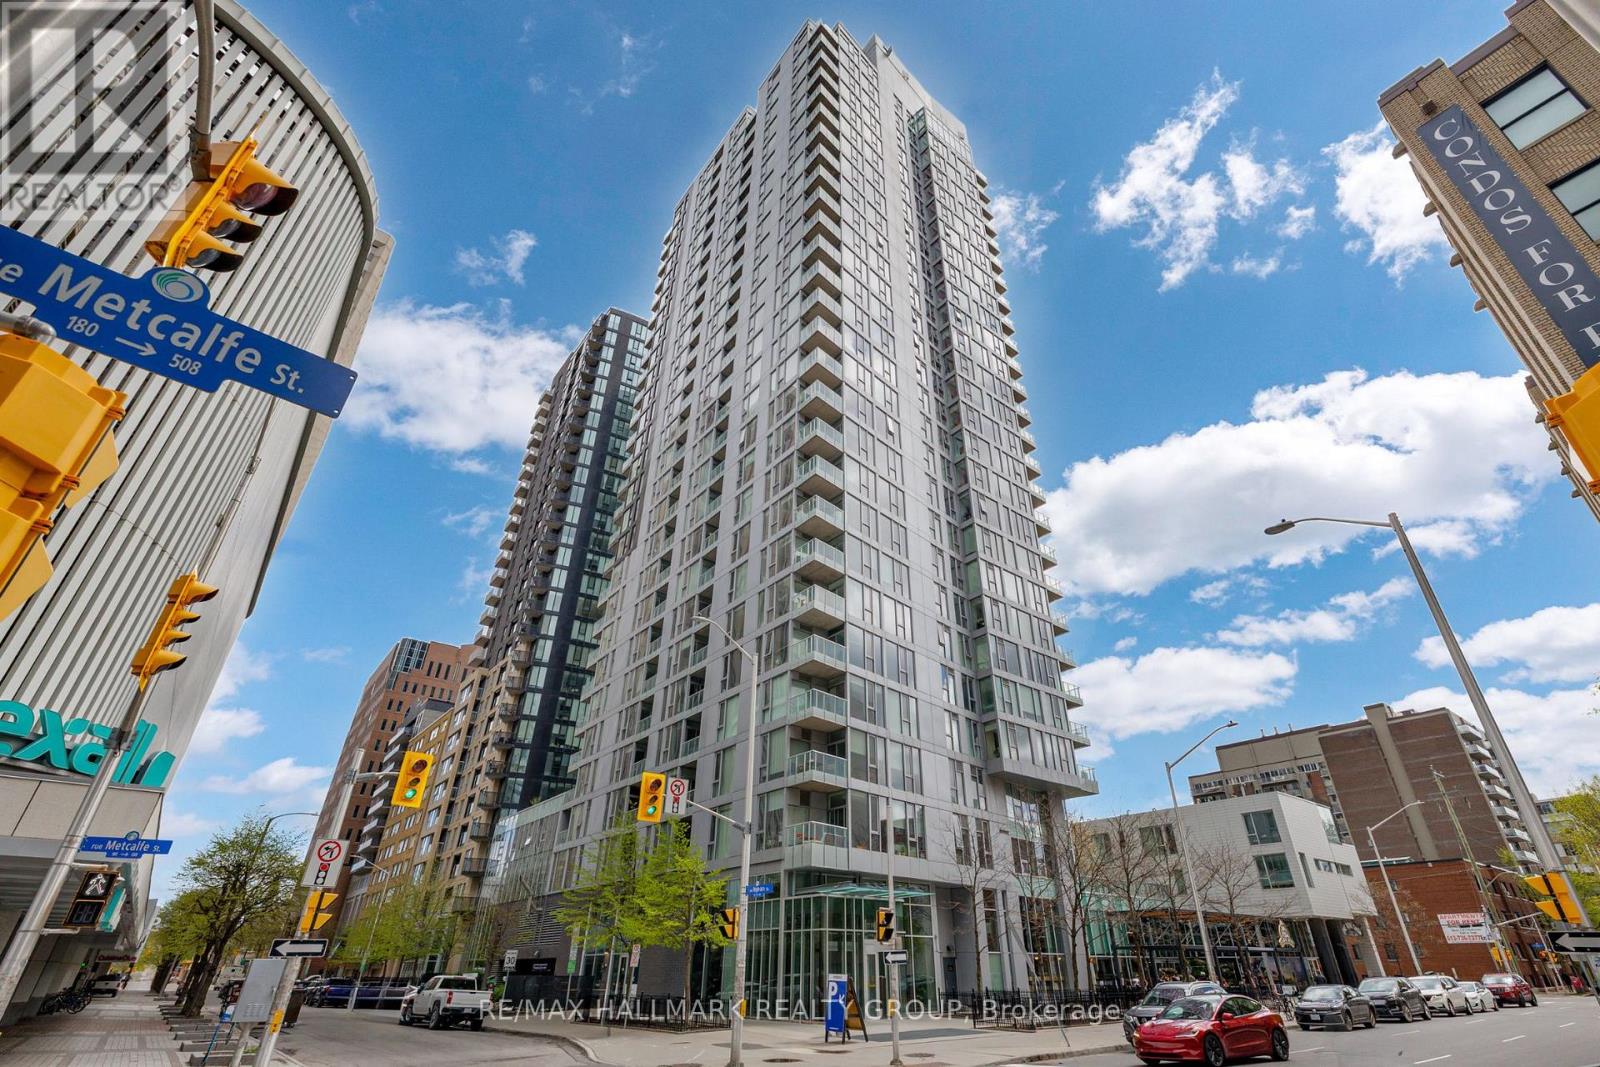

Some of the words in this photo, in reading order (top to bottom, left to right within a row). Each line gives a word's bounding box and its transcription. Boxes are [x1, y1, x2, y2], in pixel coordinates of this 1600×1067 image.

[1433, 117, 1532, 236] CONDOS
[1522, 238, 1596, 313] FOR
[37, 263, 263, 374] Metcalfe
[269, 363, 305, 394] St.
[66, 315, 99, 337] 180
[168, 353, 203, 376] 508
[105, 840, 150, 852] Metcalfe
[505, 956, 516, 964] 30
